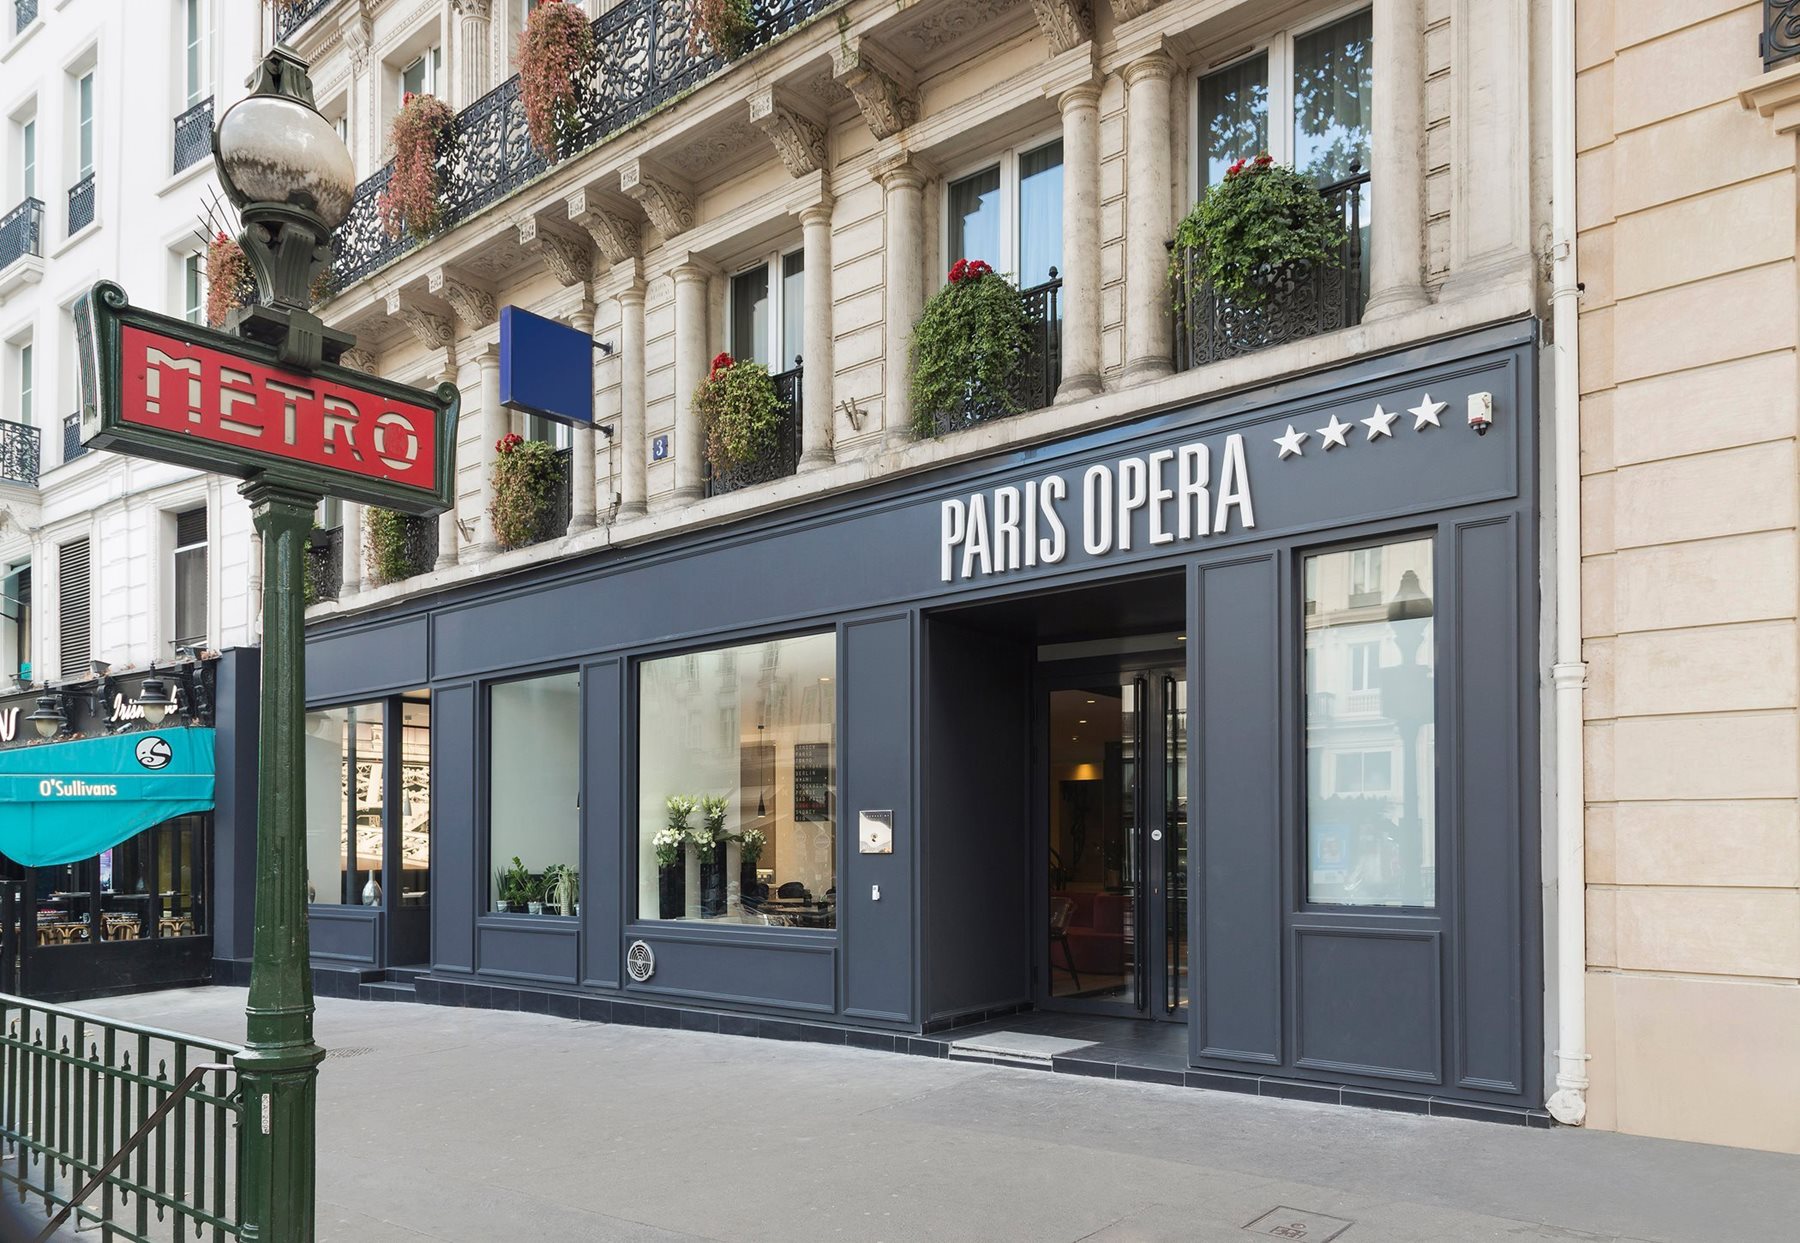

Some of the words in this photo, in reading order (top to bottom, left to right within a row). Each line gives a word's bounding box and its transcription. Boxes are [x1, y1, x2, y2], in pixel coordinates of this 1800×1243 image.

[146, 347, 418, 470] METRO
[656, 440, 664, 456] 3
[941, 475, 1066, 582] PARIS
[1082, 433, 1255, 556] OPERA
[39, 779, 117, 796] O'Sullivans
